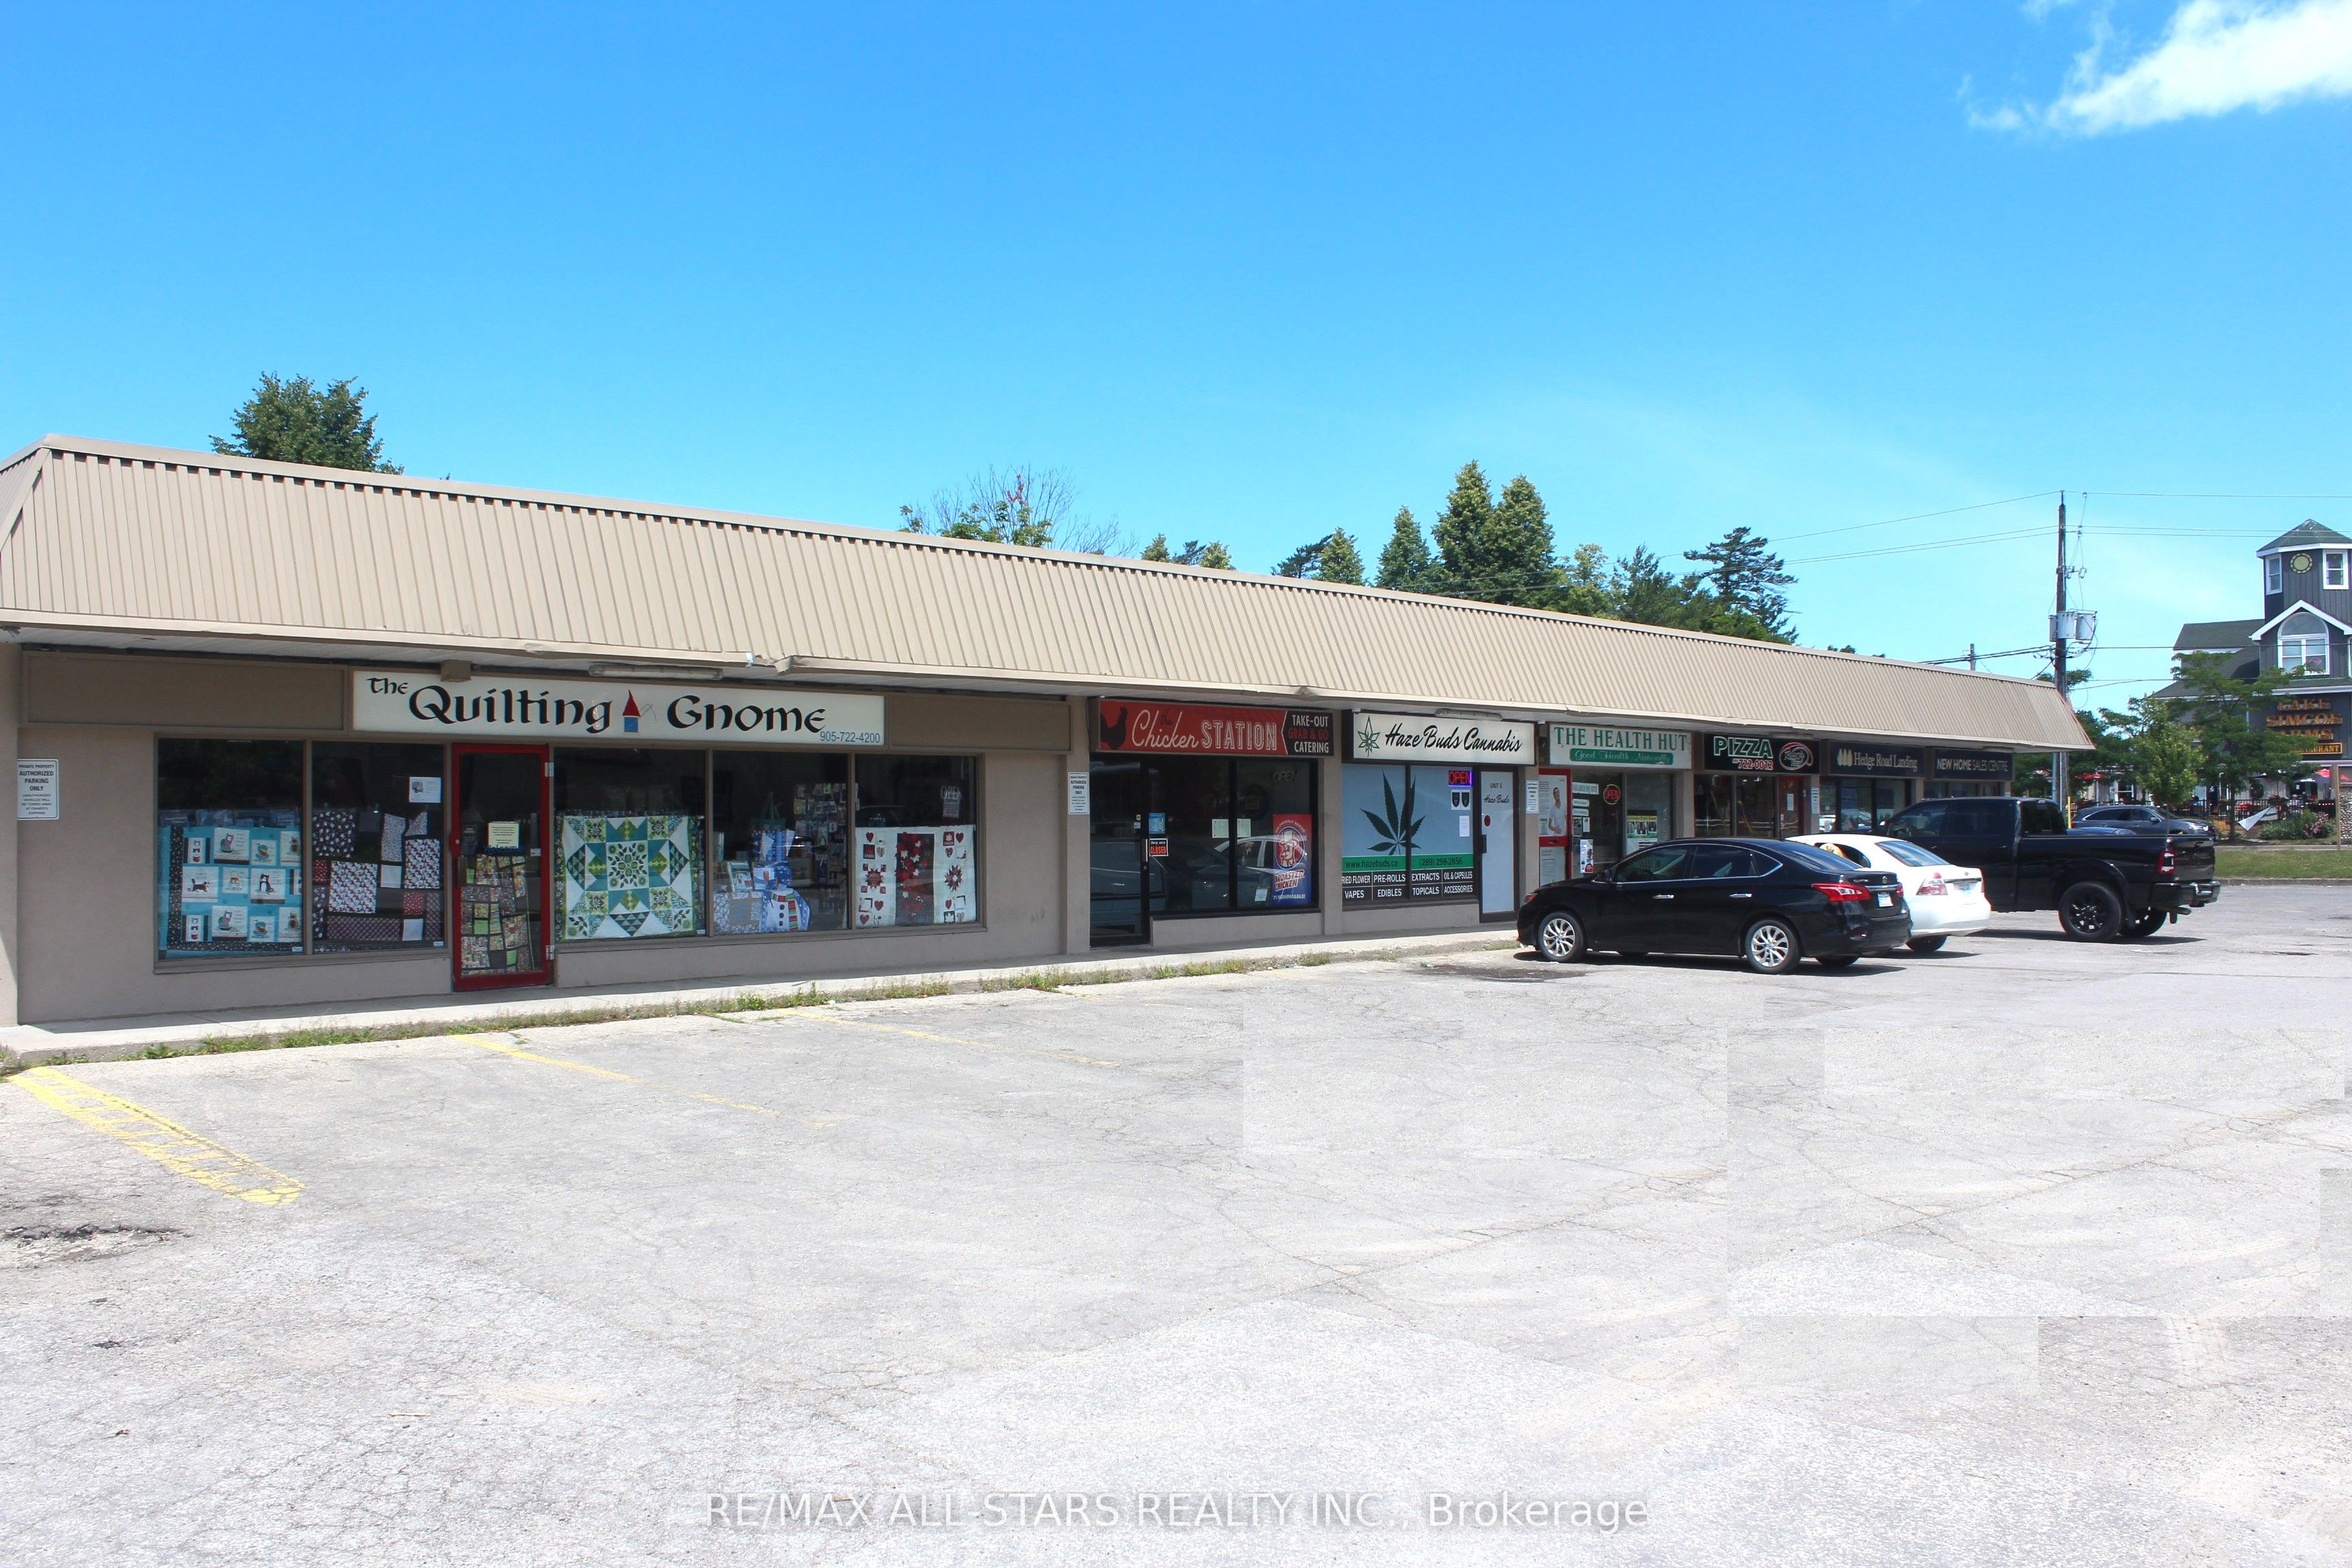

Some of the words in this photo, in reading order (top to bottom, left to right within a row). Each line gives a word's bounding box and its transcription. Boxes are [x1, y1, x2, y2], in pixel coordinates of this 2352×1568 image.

[366, 677, 408, 695] The
[409, 685, 612, 734] Quilting
[667, 695, 826, 733] Gnome
[2277, 698, 2330, 710] LAKE
[1292, 715, 1329, 728] TAKE-OUT
[2265, 713, 2342, 727] SIMCOE
[1132, 709, 1199, 748] Chicken
[1201, 719, 1277, 750] STATION
[1288, 729, 1307, 739] GRAB
[1310, 730, 1316, 740] &
[1318, 731, 1329, 740] GO
[820, 731, 881, 744] 905-722-4200
[1385, 722, 1423, 748] Haze
[1423, 725, 1463, 749] Buds
[1463, 727, 1523, 753] Cannabis
[1554, 727, 1587, 746] THE
[1594, 729, 1652, 749] HEALTH
[1658, 733, 1687, 751] HUT
[1294, 741, 1329, 753] CATERING
[1713, 736, 1774, 759] PIZZA
[1575, 750, 1595, 761] Good
[1599, 751, 1629, 760] Health
[1737, 759, 1774, 770] 722-0012
[1854, 752, 1875, 770] Hedge
[1876, 753, 1892, 766] Road
[1894, 755, 1917, 772] Landing
[1937, 758, 1952, 770] NEW
[1953, 759, 1972, 770] HOME
[1972, 760, 1987, 771] SALES
[1989, 760, 2009, 772] CENTRE
[1449, 772, 1470, 784] OPEN
[1151, 846, 1166, 854] CLOSED
[1345, 860, 1399, 868] www.hazebuds.ca
[1420, 858, 1435, 867] (289)
[1352, 875, 1371, 883] FLOWER
[1373, 874, 1406, 883] PRE-ROLLS
[1411, 872, 1440, 881] EXTRACTS
[1454, 871, 1473, 879] CAPSULES
[1345, 889, 1365, 898] VAPES
[1377, 888, 1402, 897] EDIBLES
[1412, 887, 1439, 896] TOPICALS
[1443, 885, 1473, 894] ACCESSORIES
